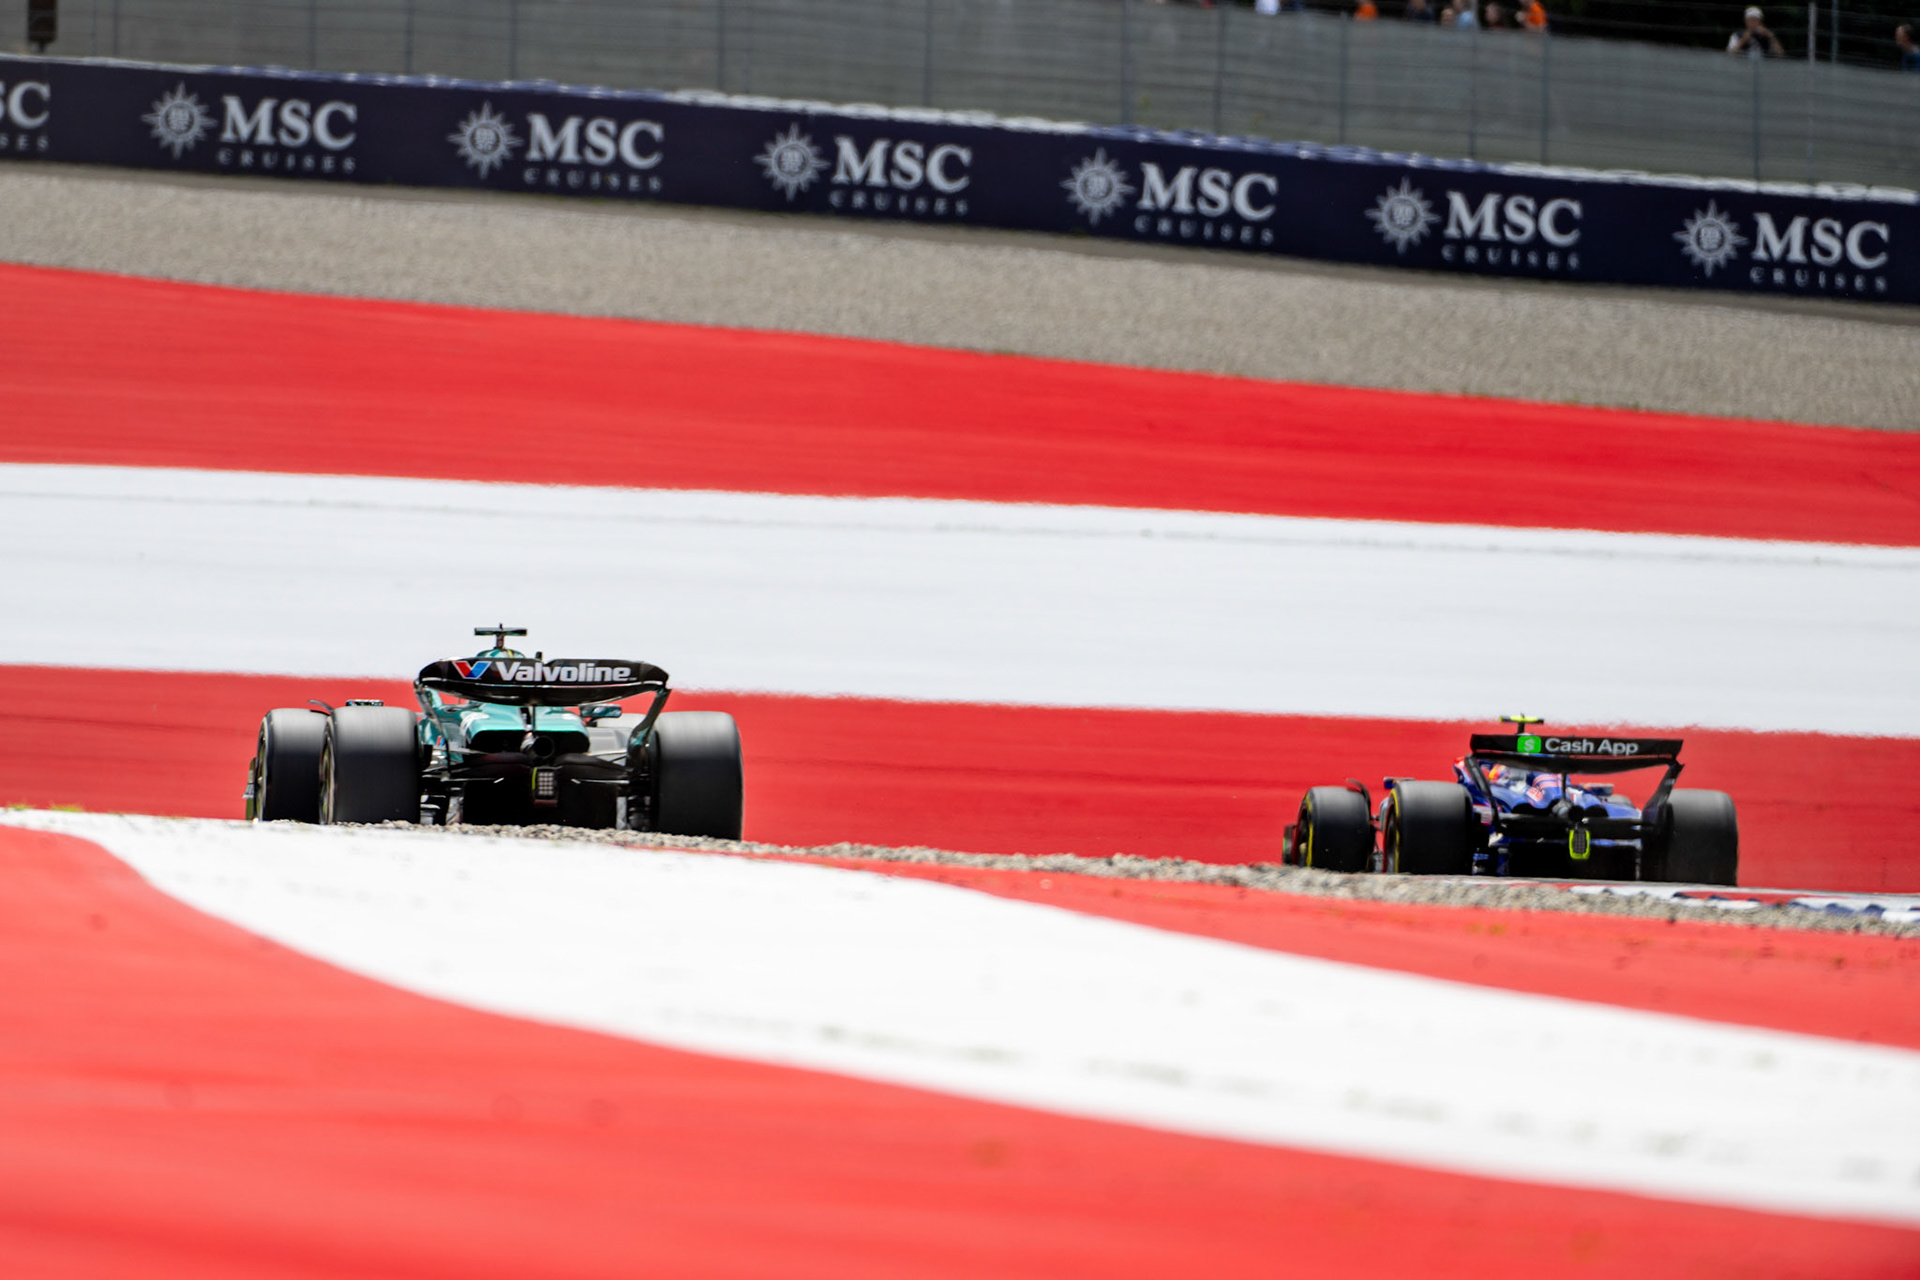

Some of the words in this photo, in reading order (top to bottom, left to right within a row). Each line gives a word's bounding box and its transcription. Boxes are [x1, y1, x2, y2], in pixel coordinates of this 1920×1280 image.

[220, 95, 358, 150] MSC
[525, 112, 664, 169] MSC
[217, 149, 357, 172] CRUISES
[831, 135, 972, 194] MSC
[523, 167, 662, 191] CRUISES
[1137, 162, 1278, 221] MSC
[829, 190, 968, 215] CRUISES
[1134, 216, 1274, 241] CRUISES
[1443, 190, 1582, 247] MSC
[1751, 212, 1889, 270] MSC
[1441, 245, 1579, 269] CRUISES
[1749, 268, 1887, 291] CRUISES
[494, 660, 632, 683] Valvoline
[1545, 737, 1594, 754] Cash
[1597, 739, 1639, 757] App
